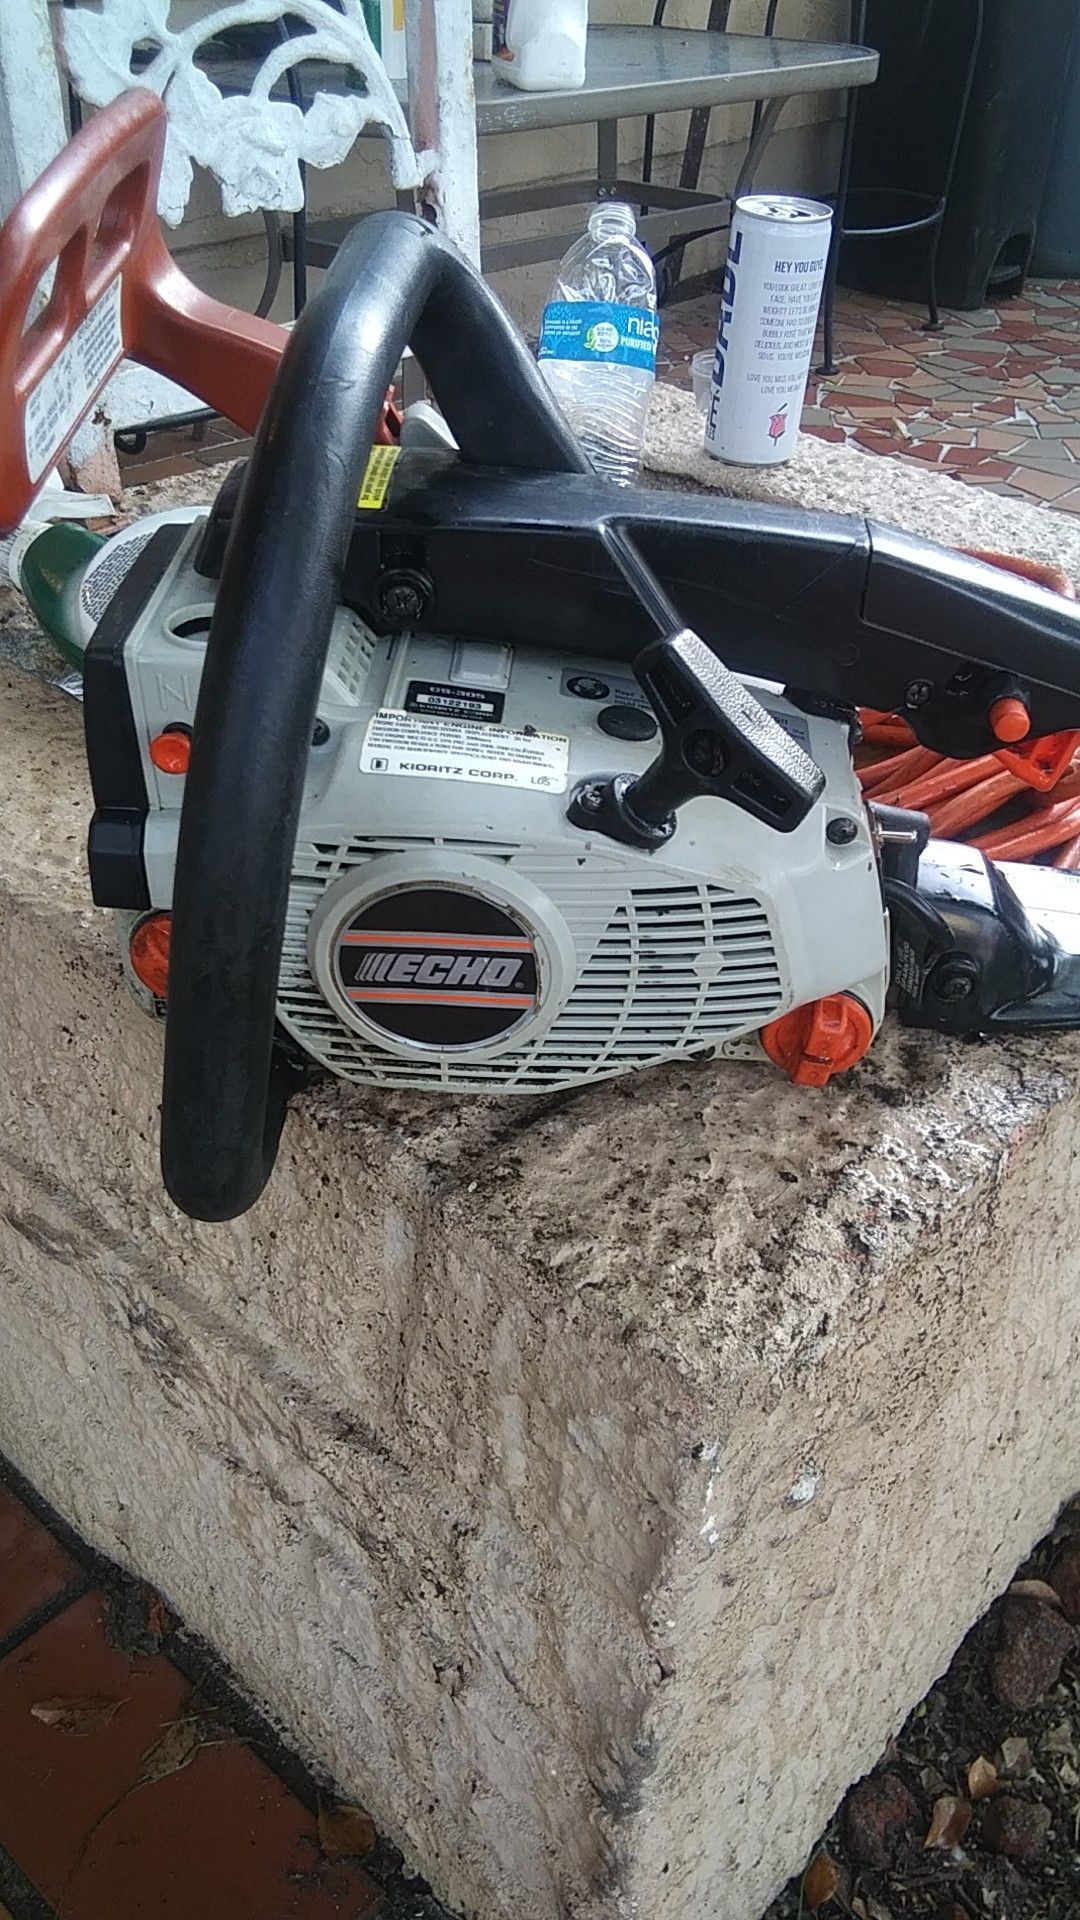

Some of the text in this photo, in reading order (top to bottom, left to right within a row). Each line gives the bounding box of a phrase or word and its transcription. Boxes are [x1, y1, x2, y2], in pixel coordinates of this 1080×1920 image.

[774, 260, 793, 273] HEY
[794, 261, 810, 273] YOU
[399, 762, 464, 775] KIORITZ
[468, 769, 518, 782] CORP.
[355, 953, 523, 987] ECHO
